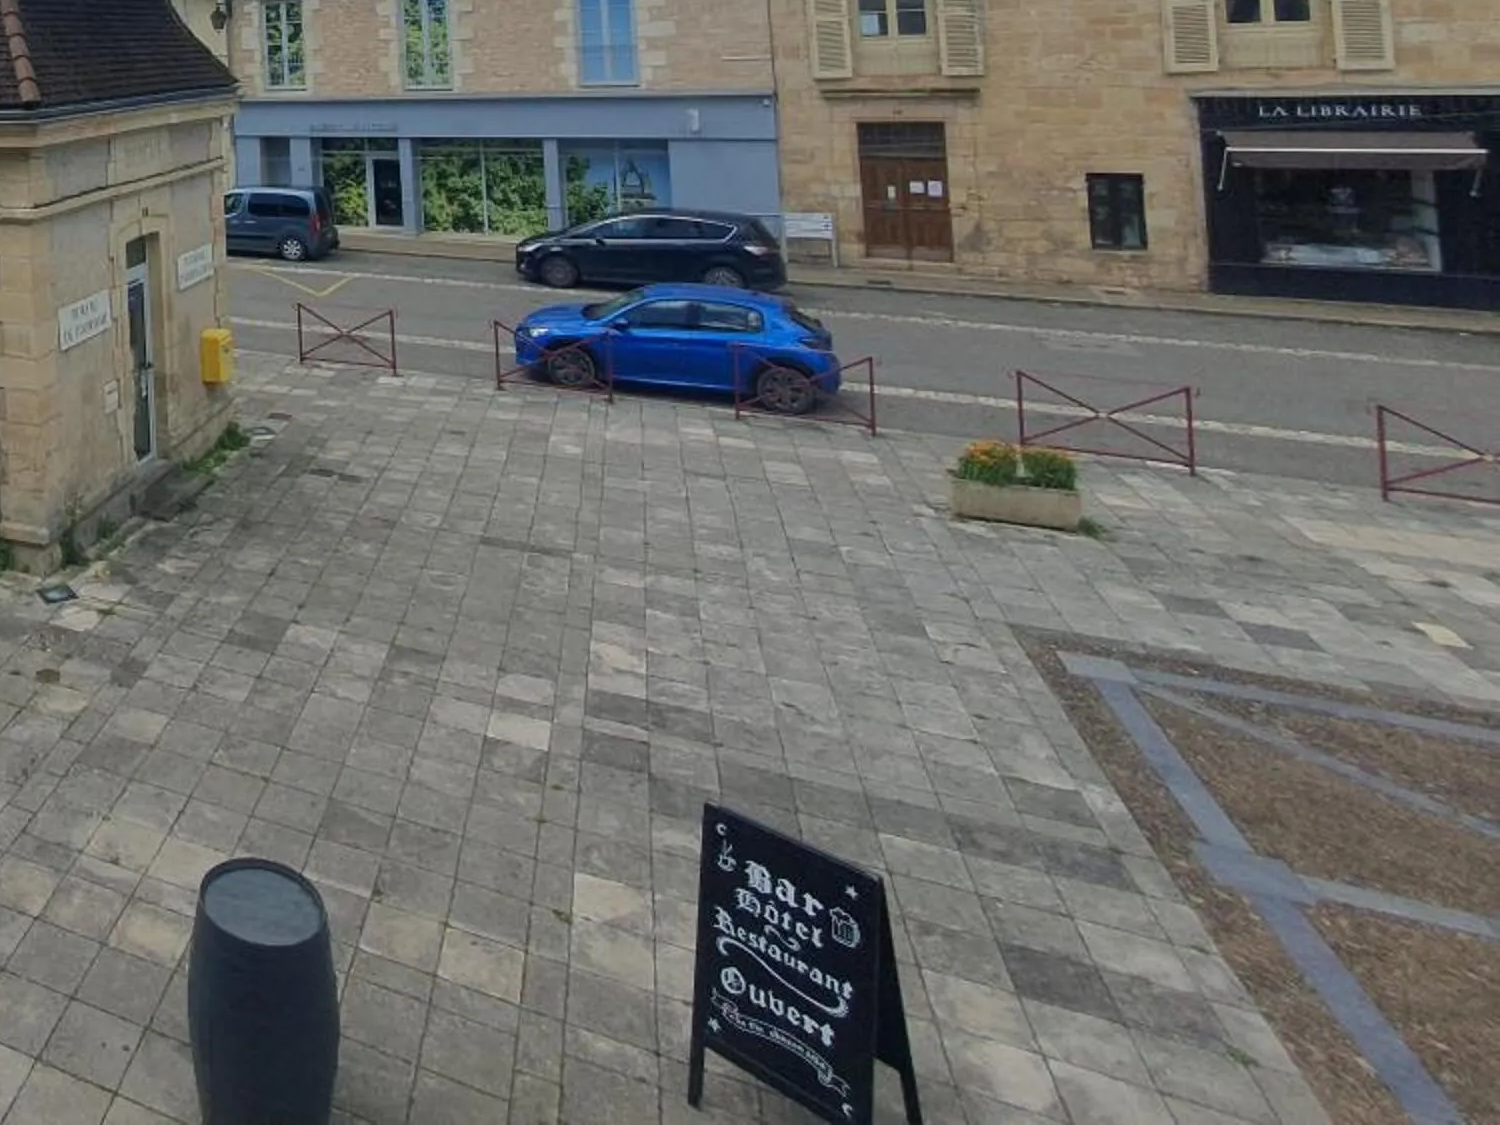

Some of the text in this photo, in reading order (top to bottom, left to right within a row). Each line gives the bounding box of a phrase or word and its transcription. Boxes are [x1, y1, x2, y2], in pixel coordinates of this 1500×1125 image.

[1259, 104, 1423, 117] LA LIBRAIRIE
[745, 860, 824, 916] Bar
[735, 888, 824, 948] Hôtel
[713, 905, 853, 999] Restaurant
